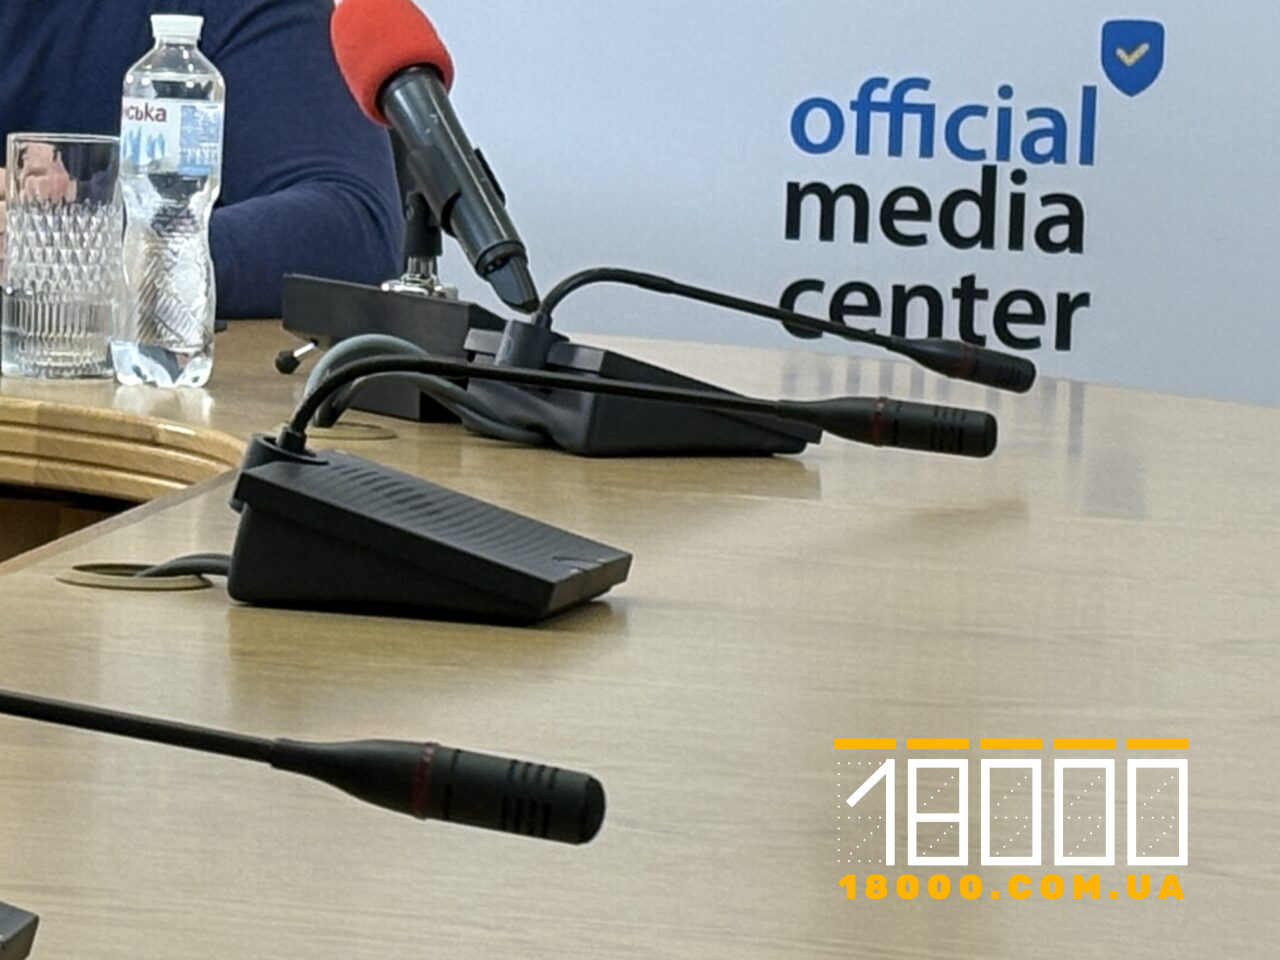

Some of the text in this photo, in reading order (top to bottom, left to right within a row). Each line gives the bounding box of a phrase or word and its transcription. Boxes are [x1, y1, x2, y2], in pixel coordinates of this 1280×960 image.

[124, 102, 167, 122] ська
[790, 77, 1097, 166] official
[784, 164, 1085, 254] media
[780, 274, 1091, 351] center
